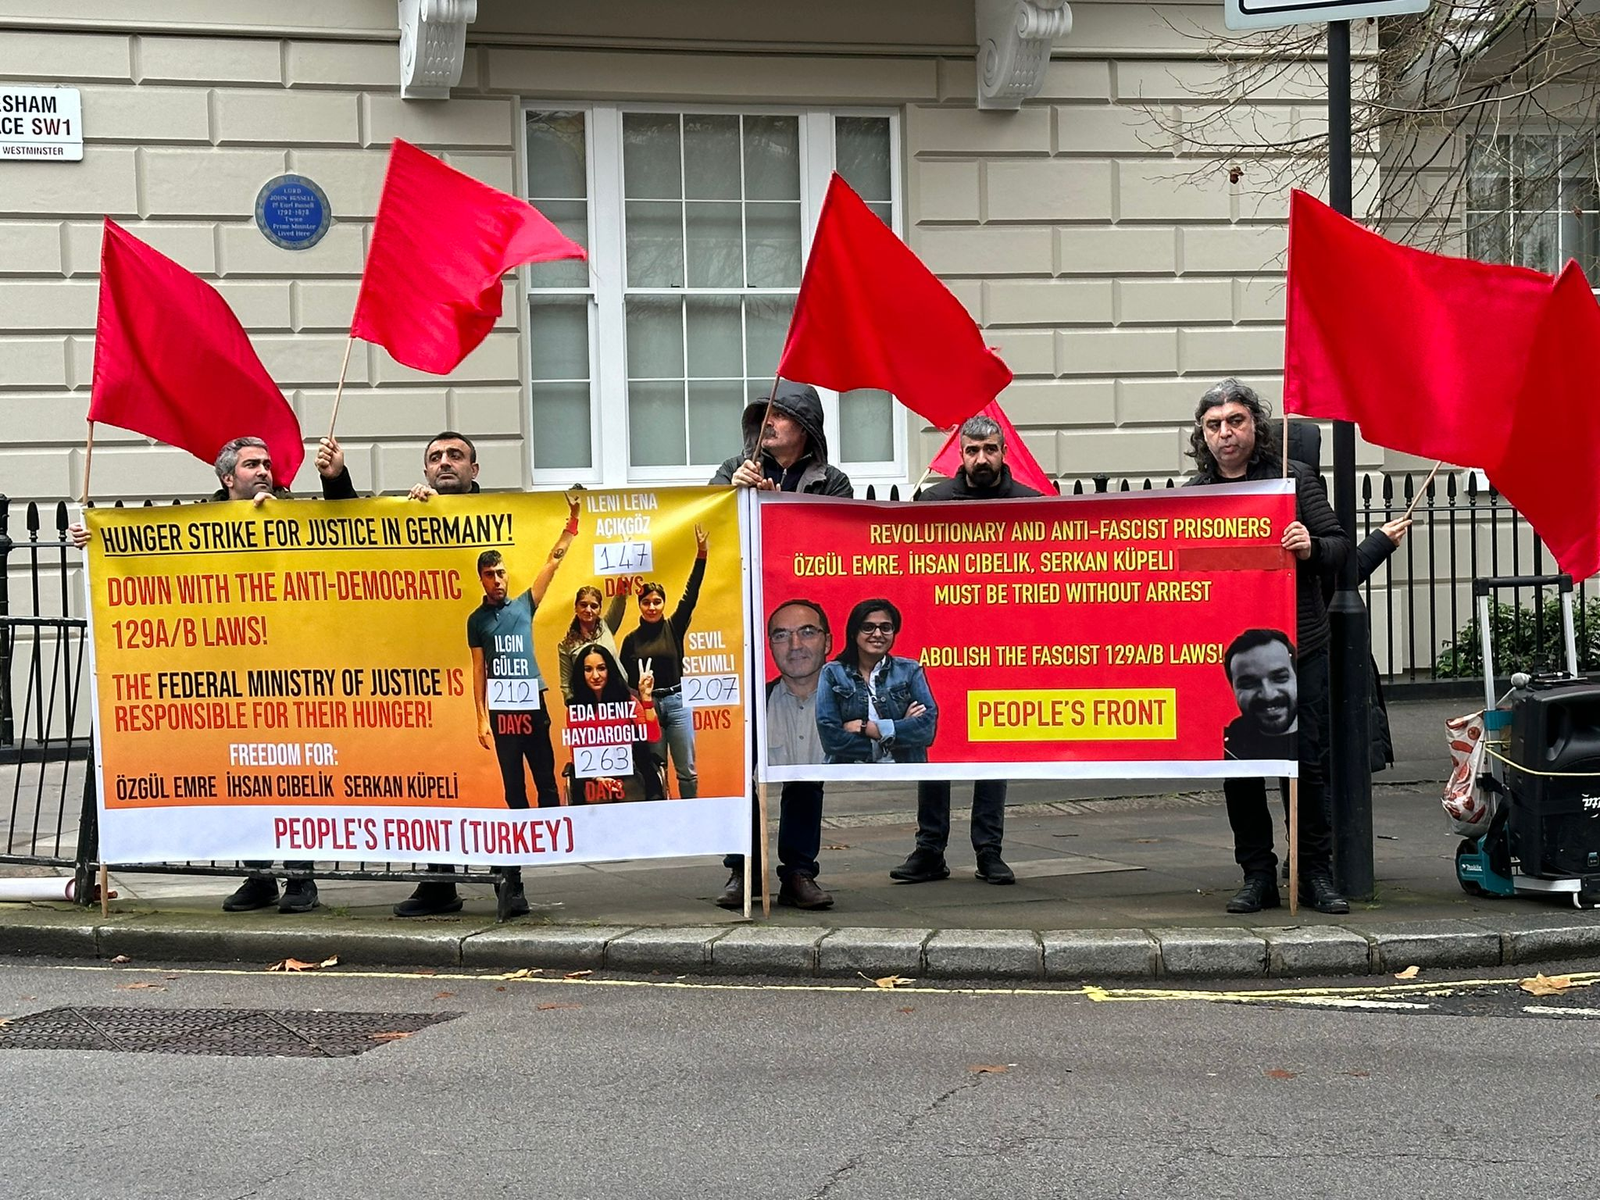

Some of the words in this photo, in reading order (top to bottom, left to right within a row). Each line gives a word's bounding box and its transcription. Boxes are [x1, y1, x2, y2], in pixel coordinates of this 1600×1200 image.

[0, 95, 57, 113] SHAM
[0, 117, 24, 135] CE
[32, 118, 71, 136] SW1
[3, 146, 64, 156] WESTMINSTER
[587, 495, 621, 514] ILENI
[624, 493, 659, 511] LENA
[100, 524, 183, 553] HUNGER
[188, 520, 258, 550] STRIKE
[264, 519, 301, 547] FOR
[306, 517, 378, 546] JUSTICE
[381, 517, 401, 545] IN
[405, 513, 513, 544] GERMANY!
[596, 515, 651, 538] AÇIKGÖZ
[870, 521, 1006, 545] REVOLUTIONARY
[1011, 521, 1046, 542] AND
[1051, 518, 1169, 542] ANTI-FASCIST
[1173, 517, 1272, 539] PRISONERS
[599, 543, 649, 571] 147
[793, 553, 847, 577] ÖZGÜL
[852, 554, 904, 577] EMRE,
[909, 551, 960, 575] İHSAN
[965, 552, 1036, 574] CIBELIK,
[1040, 551, 1109, 573] SERKAN
[1113, 547, 1174, 571] KÜPELI
[107, 574, 172, 607] DOWN
[176, 573, 230, 605] WITH
[235, 572, 277, 603] THE
[283, 569, 463, 601] ANTI-DEMOCRATIC
[604, 575, 645, 598] DAYS
[935, 584, 981, 605] MUST
[986, 584, 1008, 604] BE
[1012, 583, 1060, 604] TRIED
[1065, 582, 1142, 604] WITHOUT
[1146, 581, 1212, 602] ARREST
[112, 617, 197, 650] 129A/B
[202, 615, 268, 647] LAWS!
[494, 635, 524, 653] ILGIN
[689, 631, 726, 650] SEVIL
[492, 656, 529, 677] GÜLER
[682, 654, 735, 674] SEVIMLI
[919, 646, 991, 667] ABOLISH
[995, 645, 1027, 666] THE
[1032, 645, 1100, 666] FASCIST
[1105, 644, 1164, 665] 129A/B
[1169, 643, 1224, 664] LAWS!
[112, 673, 152, 701] THE
[157, 670, 243, 699] FEDERAL
[249, 668, 338, 698] MINISTRY
[342, 668, 364, 696] OF
[370, 668, 443, 697] JUSTICE
[447, 668, 464, 696] IS
[493, 680, 533, 704] 212
[688, 677, 738, 701] 207
[114, 701, 248, 732] RESPONSIBLE
[254, 701, 288, 729] FOR
[293, 700, 347, 728] THEIR
[353, 700, 433, 728] HUNGER!
[569, 704, 596, 723] EDA
[597, 701, 637, 721] DENIZ
[693, 709, 731, 731] DAYS
[1093, 699, 1166, 726] FRONT
[497, 714, 533, 735] DAYS
[562, 723, 648, 746] HAYDAROGLU
[229, 743, 301, 766] FREEDOM
[305, 742, 339, 766] FOR:
[580, 747, 629, 772] 263
[116, 773, 170, 800] ÖZGÜL
[173, 775, 217, 798] EMRE
[226, 771, 273, 798] İHSAN
[343, 774, 402, 798] SERKAN
[407, 772, 459, 800] KÜPELİ
[585, 780, 625, 800] DAYS
[274, 817, 377, 850] PEOPLE'S
[384, 818, 453, 851] FRONT
[460, 817, 575, 855] (TURKEY)
